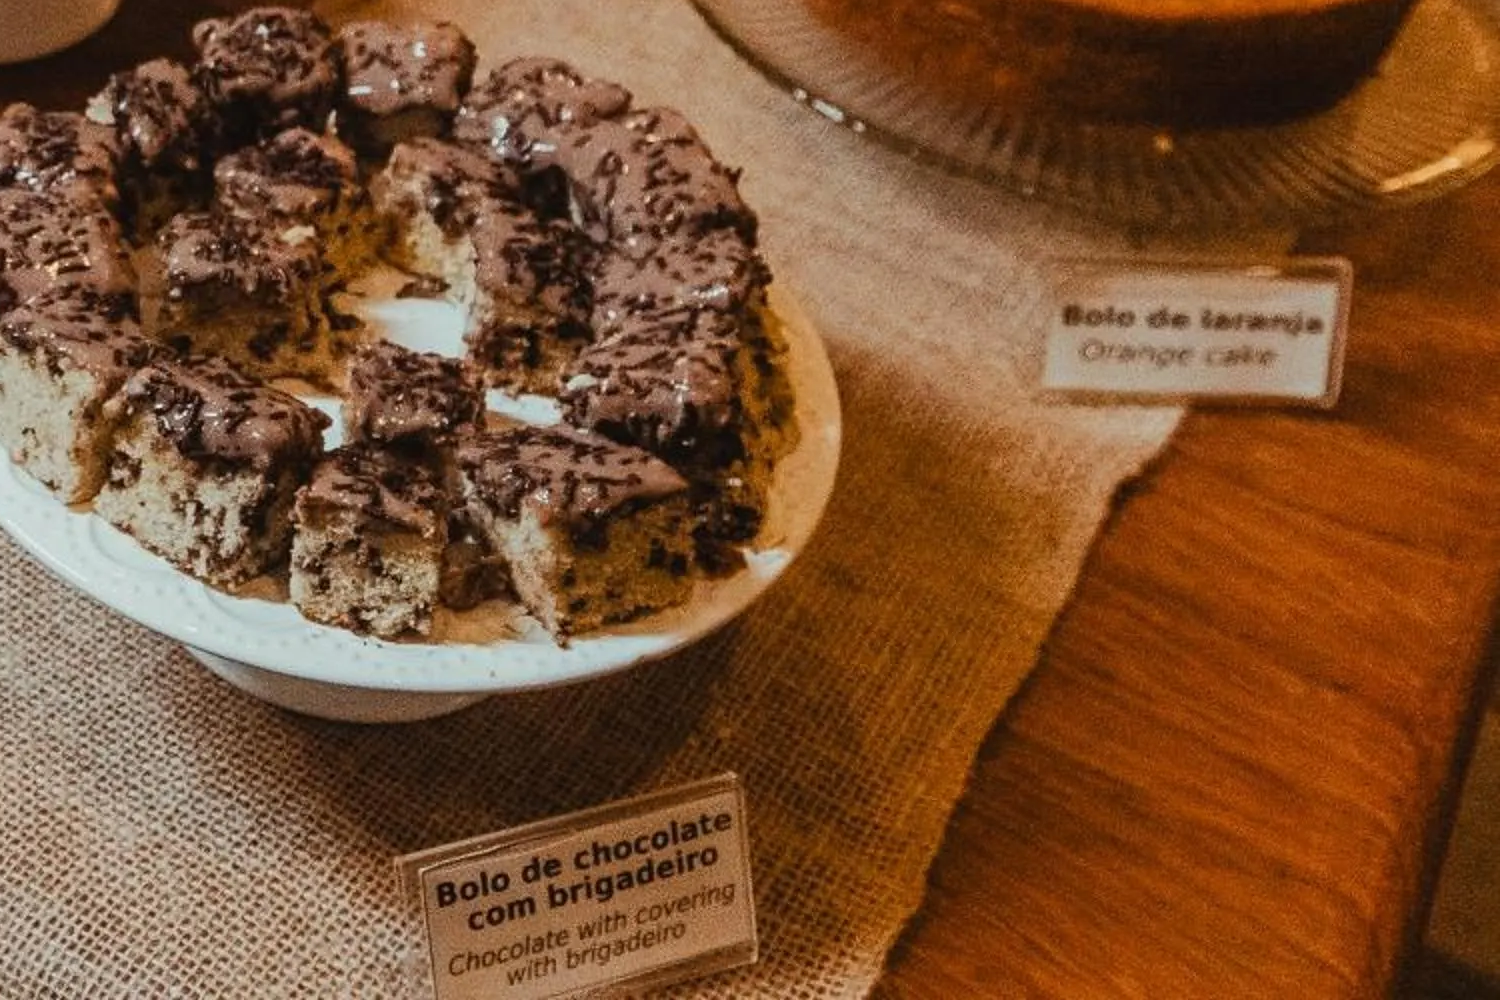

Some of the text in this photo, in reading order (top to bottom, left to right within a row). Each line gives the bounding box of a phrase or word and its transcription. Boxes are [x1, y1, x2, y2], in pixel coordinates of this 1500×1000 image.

[1062, 303, 1323, 336] Bolo de laranja
[1079, 338, 1281, 369] Orange cake
[436, 813, 732, 908] Bolo de chocolate
[467, 847, 719, 930] com brigadeiro
[448, 883, 736, 977] Chocolate with covering
[506, 922, 687, 986] with brigadeiro
